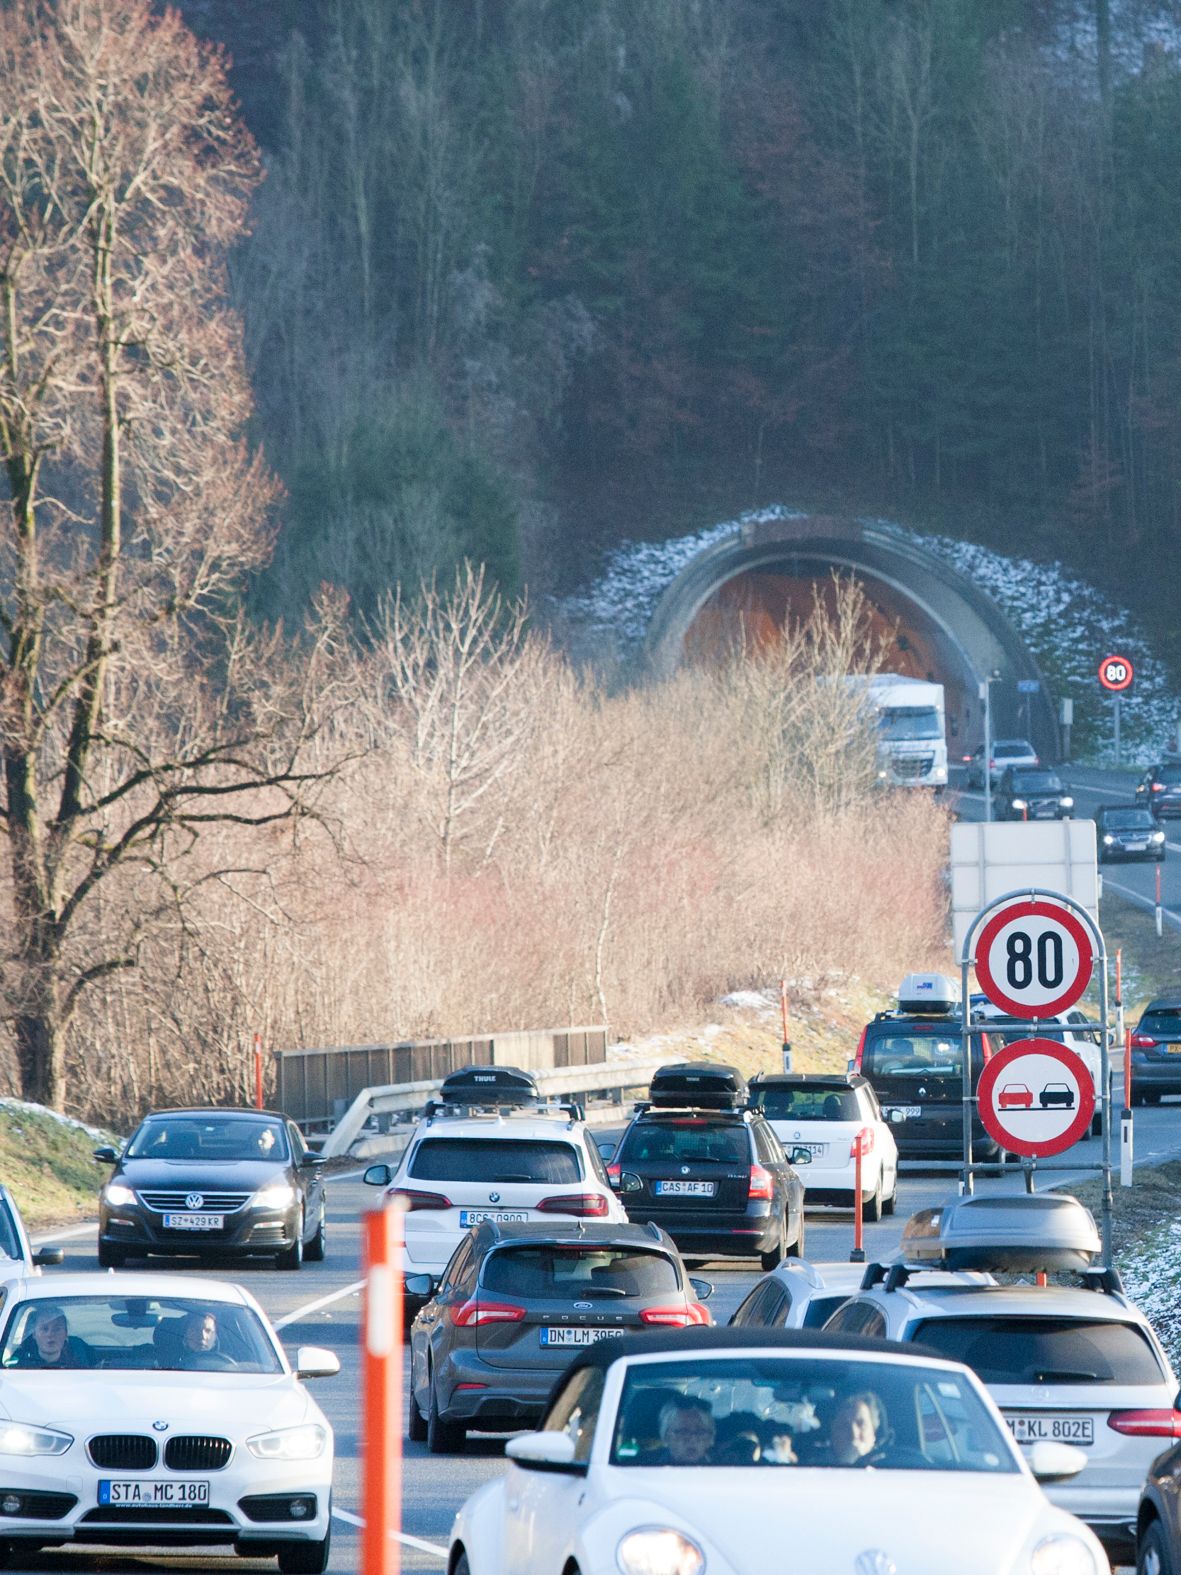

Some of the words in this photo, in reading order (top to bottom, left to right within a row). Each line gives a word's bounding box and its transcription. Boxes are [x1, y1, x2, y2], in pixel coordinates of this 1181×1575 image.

[1106, 665, 1126, 681] 80
[1007, 931, 1063, 990] 80
[662, 1182, 681, 1192] CAS
[687, 1183, 699, 1193] AF
[701, 1183, 713, 1193] 10
[171, 1216, 183, 1226] SZ
[549, 1329, 565, 1343] DN
[574, 1330, 590, 1343] LM
[1028, 1420, 1047, 1437] KL
[1052, 1420, 1091, 1438] 802E
[112, 1484, 141, 1501] STA
[154, 1484, 173, 1501] MC
[178, 1484, 207, 1501] 180
